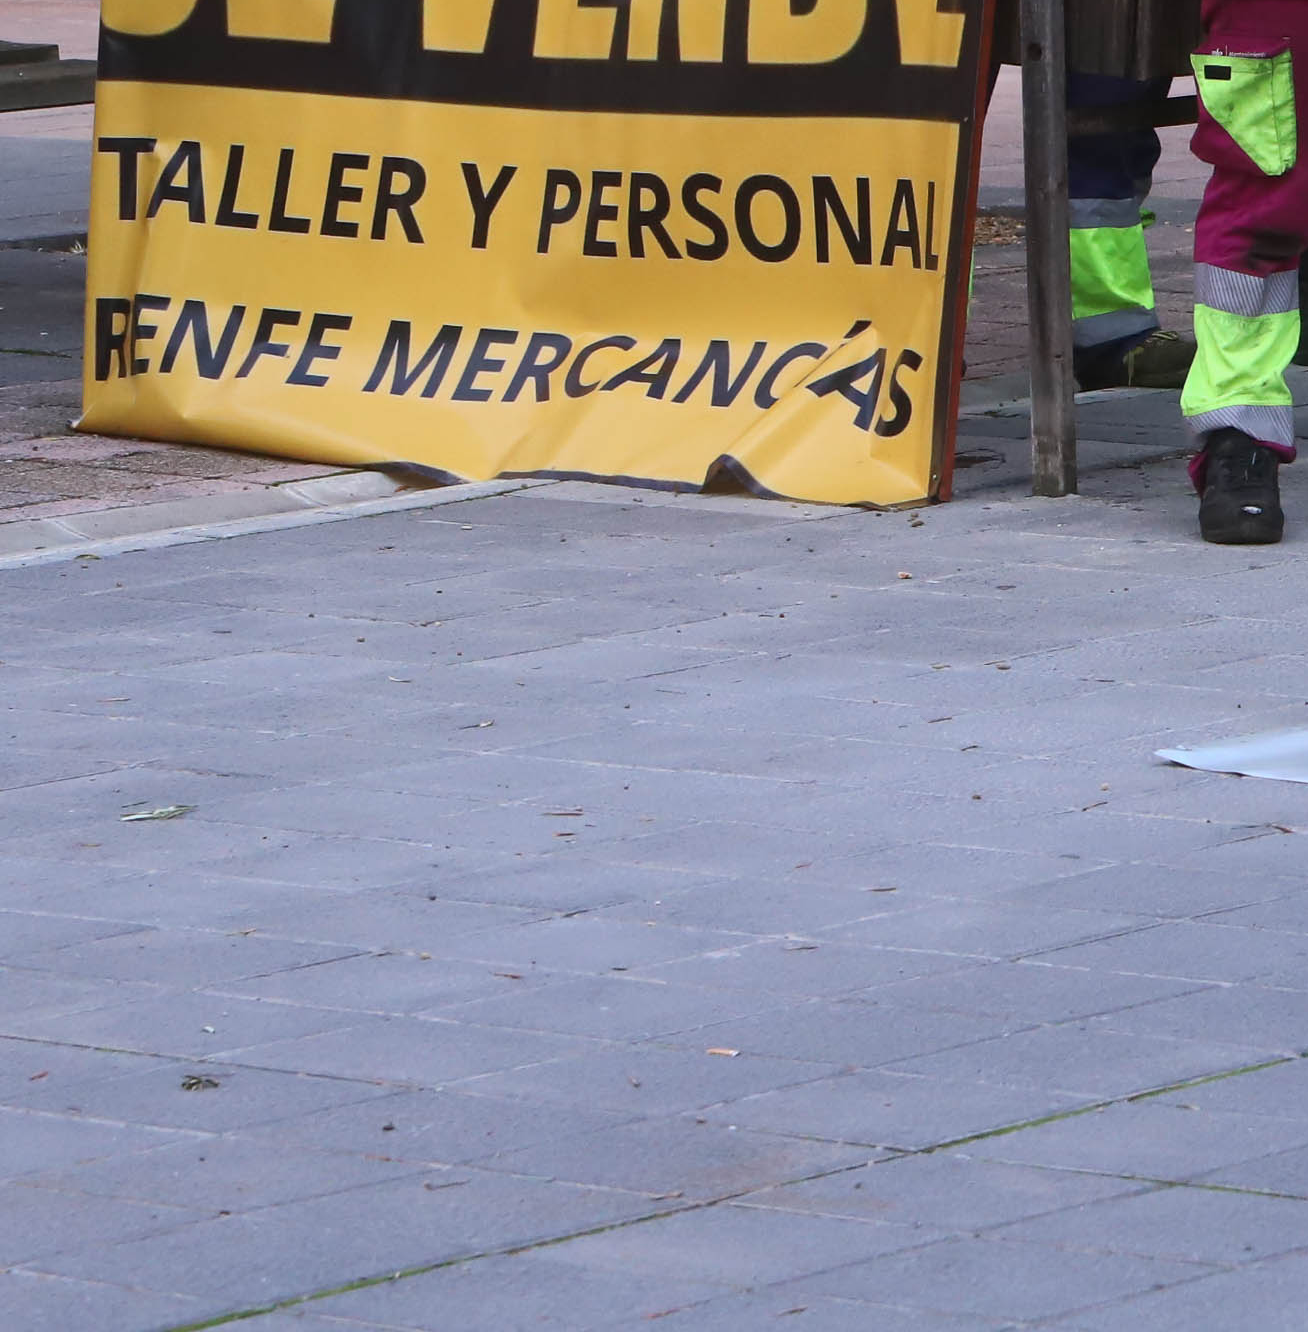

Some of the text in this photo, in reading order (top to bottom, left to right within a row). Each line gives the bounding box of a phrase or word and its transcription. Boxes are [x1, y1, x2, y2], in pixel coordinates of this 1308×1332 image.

[98, 137, 939, 272] TALLER Y PERSONAL
[95, 293, 353, 388] RENFE
